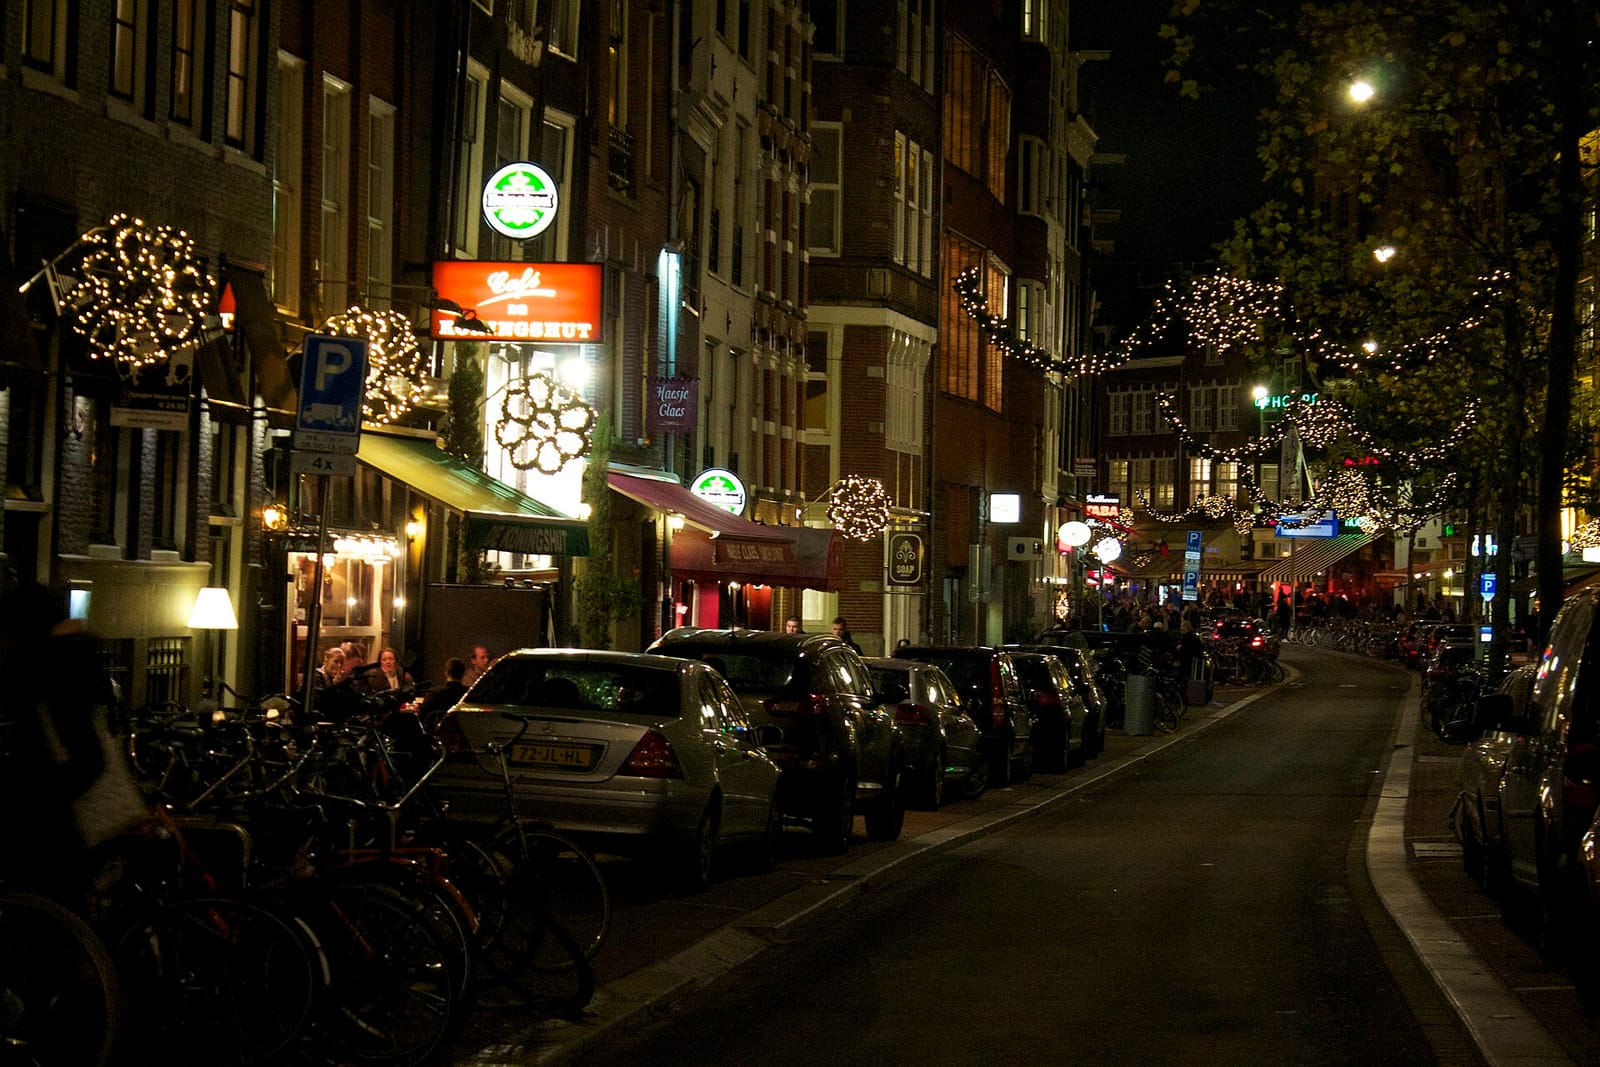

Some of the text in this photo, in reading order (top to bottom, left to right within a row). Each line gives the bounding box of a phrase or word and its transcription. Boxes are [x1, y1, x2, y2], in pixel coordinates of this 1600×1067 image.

[314, 342, 352, 391] P
[1190, 533, 1198, 543] P
[1485, 580, 1492, 591] P
